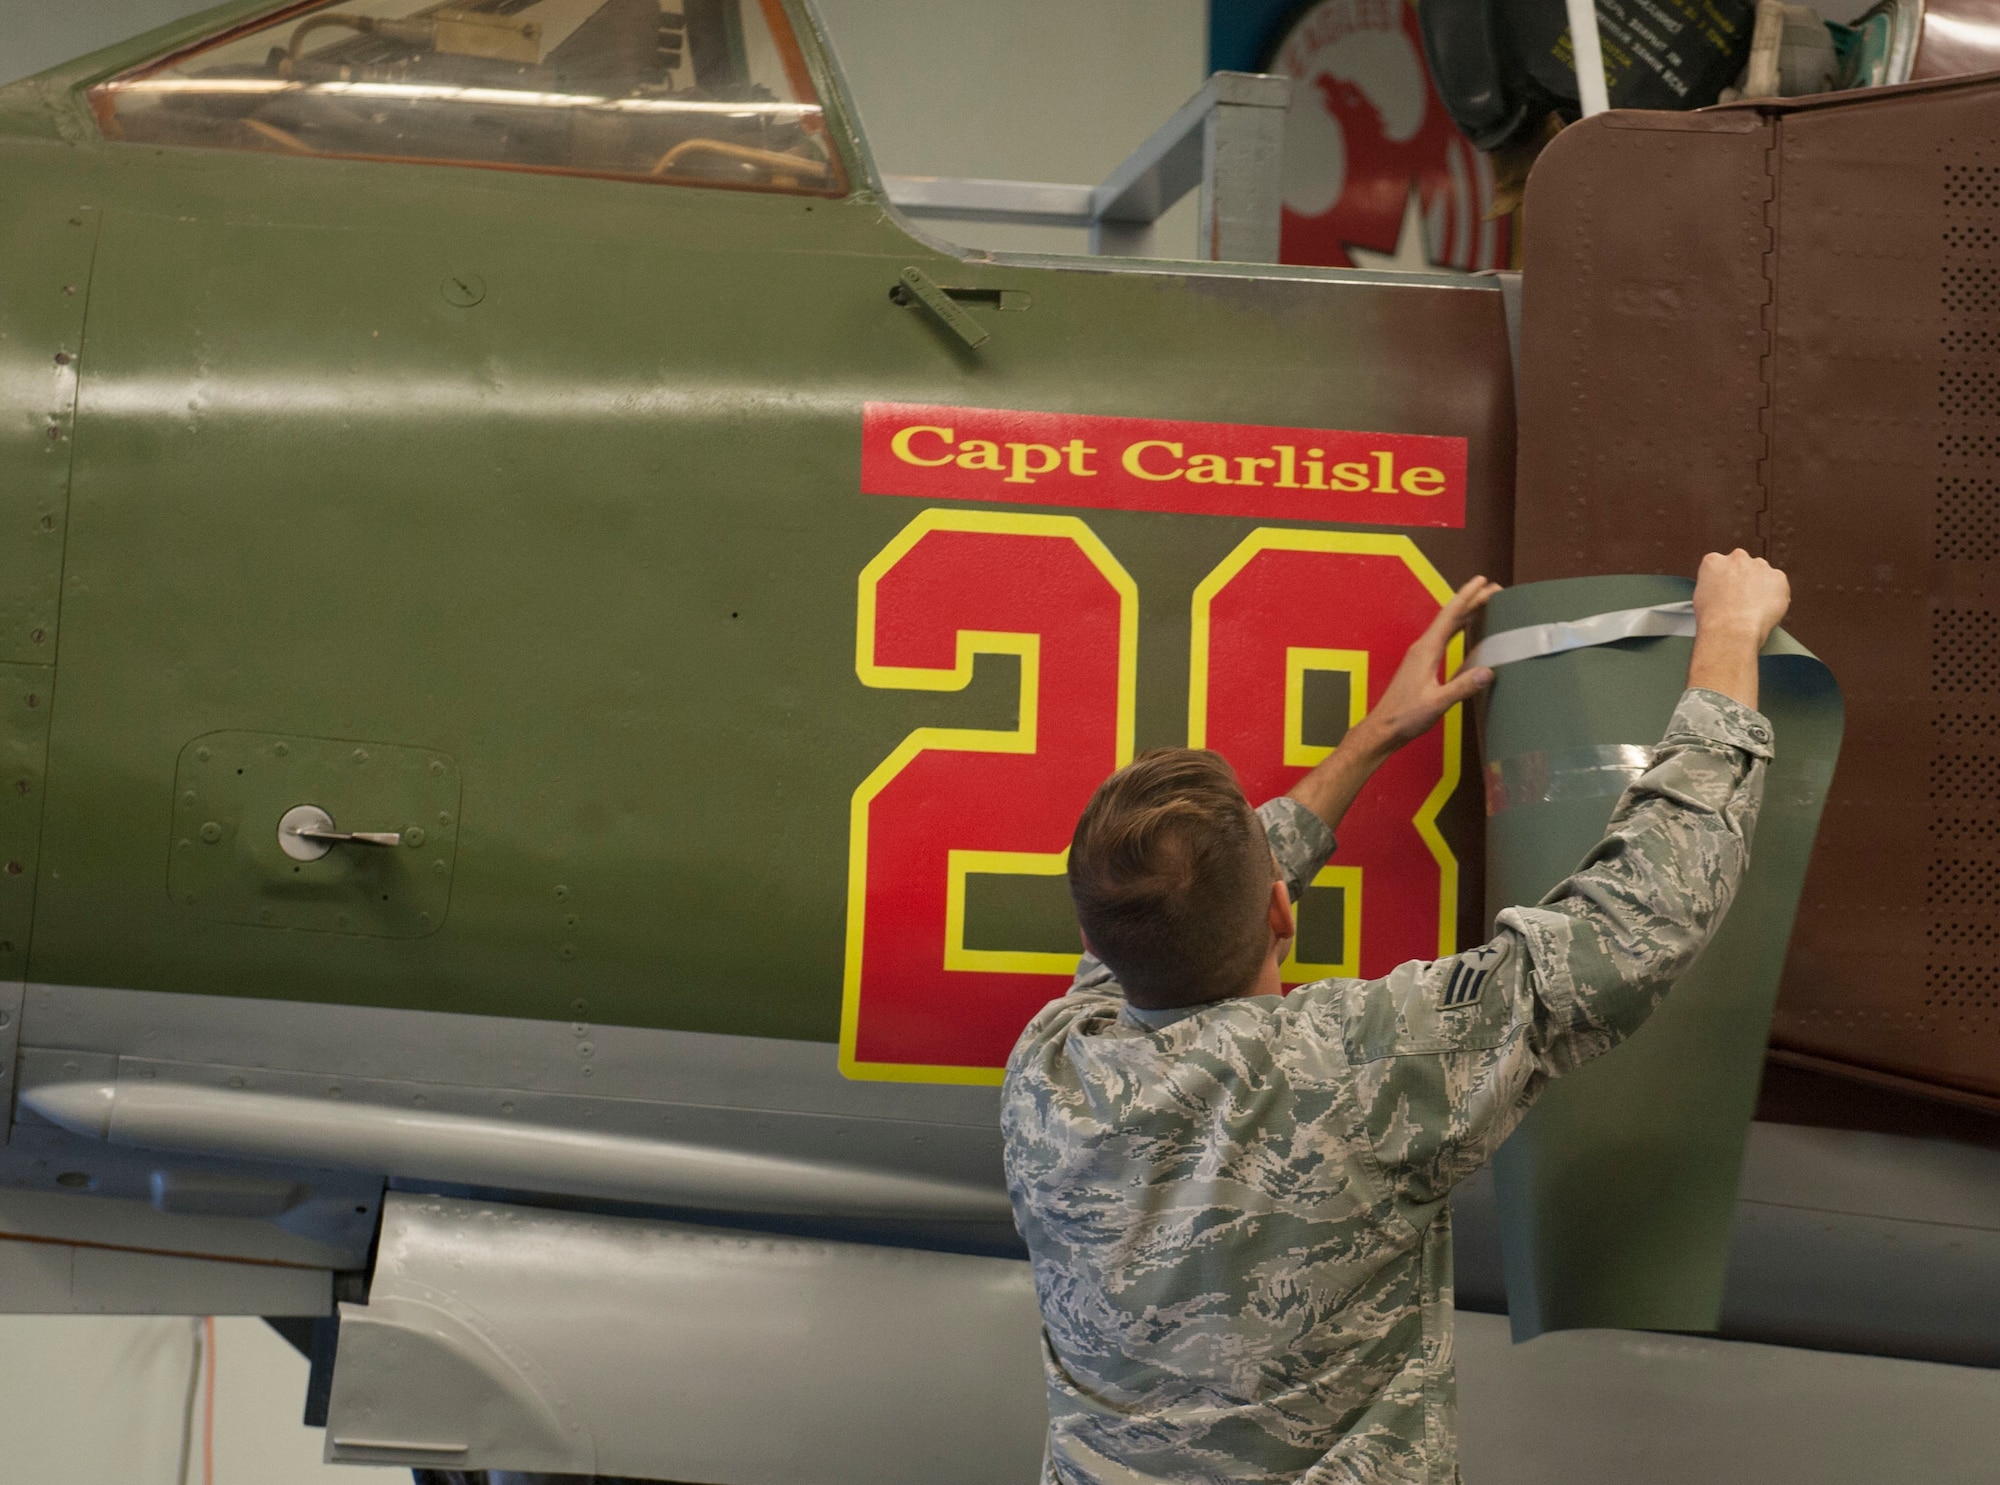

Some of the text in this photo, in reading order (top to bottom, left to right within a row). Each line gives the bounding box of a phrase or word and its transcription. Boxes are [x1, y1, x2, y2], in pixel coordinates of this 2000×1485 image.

[890, 424, 1447, 497] Capt Carlisle
[838, 508, 1463, 1084] 28
